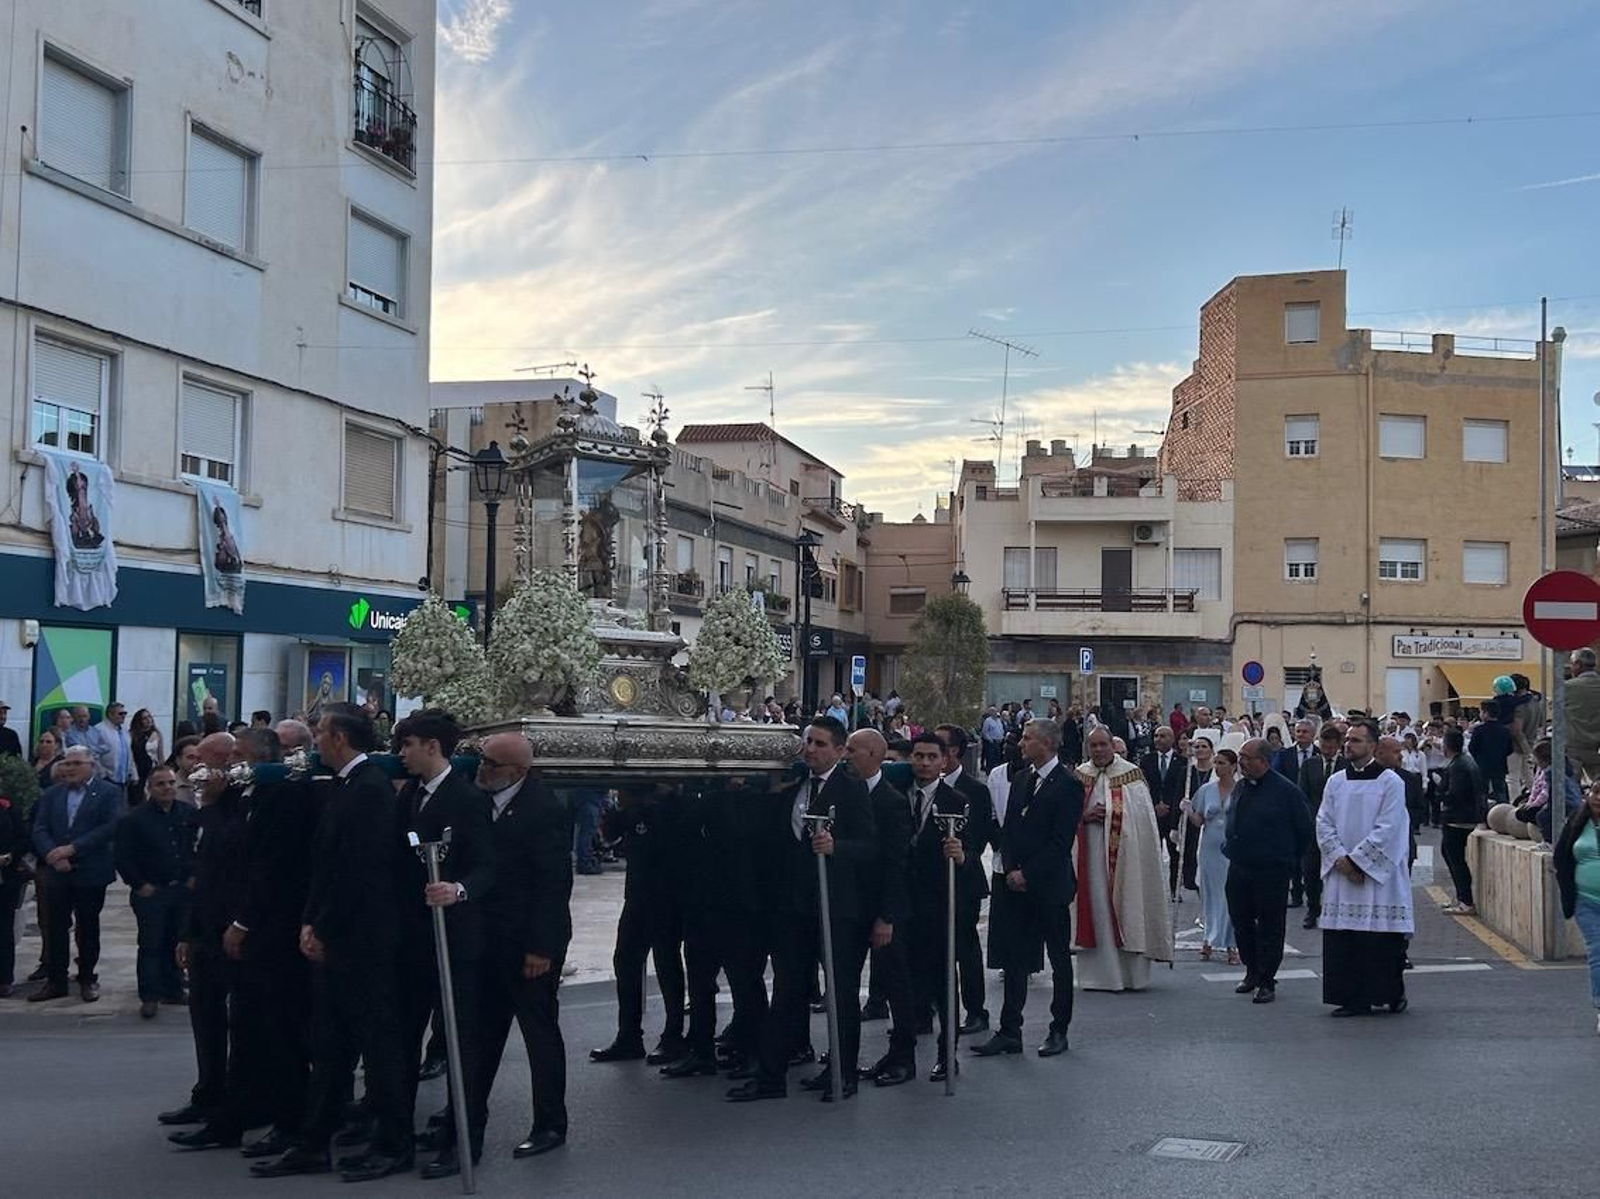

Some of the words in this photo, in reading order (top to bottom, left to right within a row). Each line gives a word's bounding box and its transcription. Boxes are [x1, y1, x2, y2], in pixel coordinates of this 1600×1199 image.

[371, 611, 408, 629] Unicaj
[1397, 639, 1412, 654] Pan
[1414, 639, 1463, 654] Tradicional
[1083, 651, 1090, 669] P
